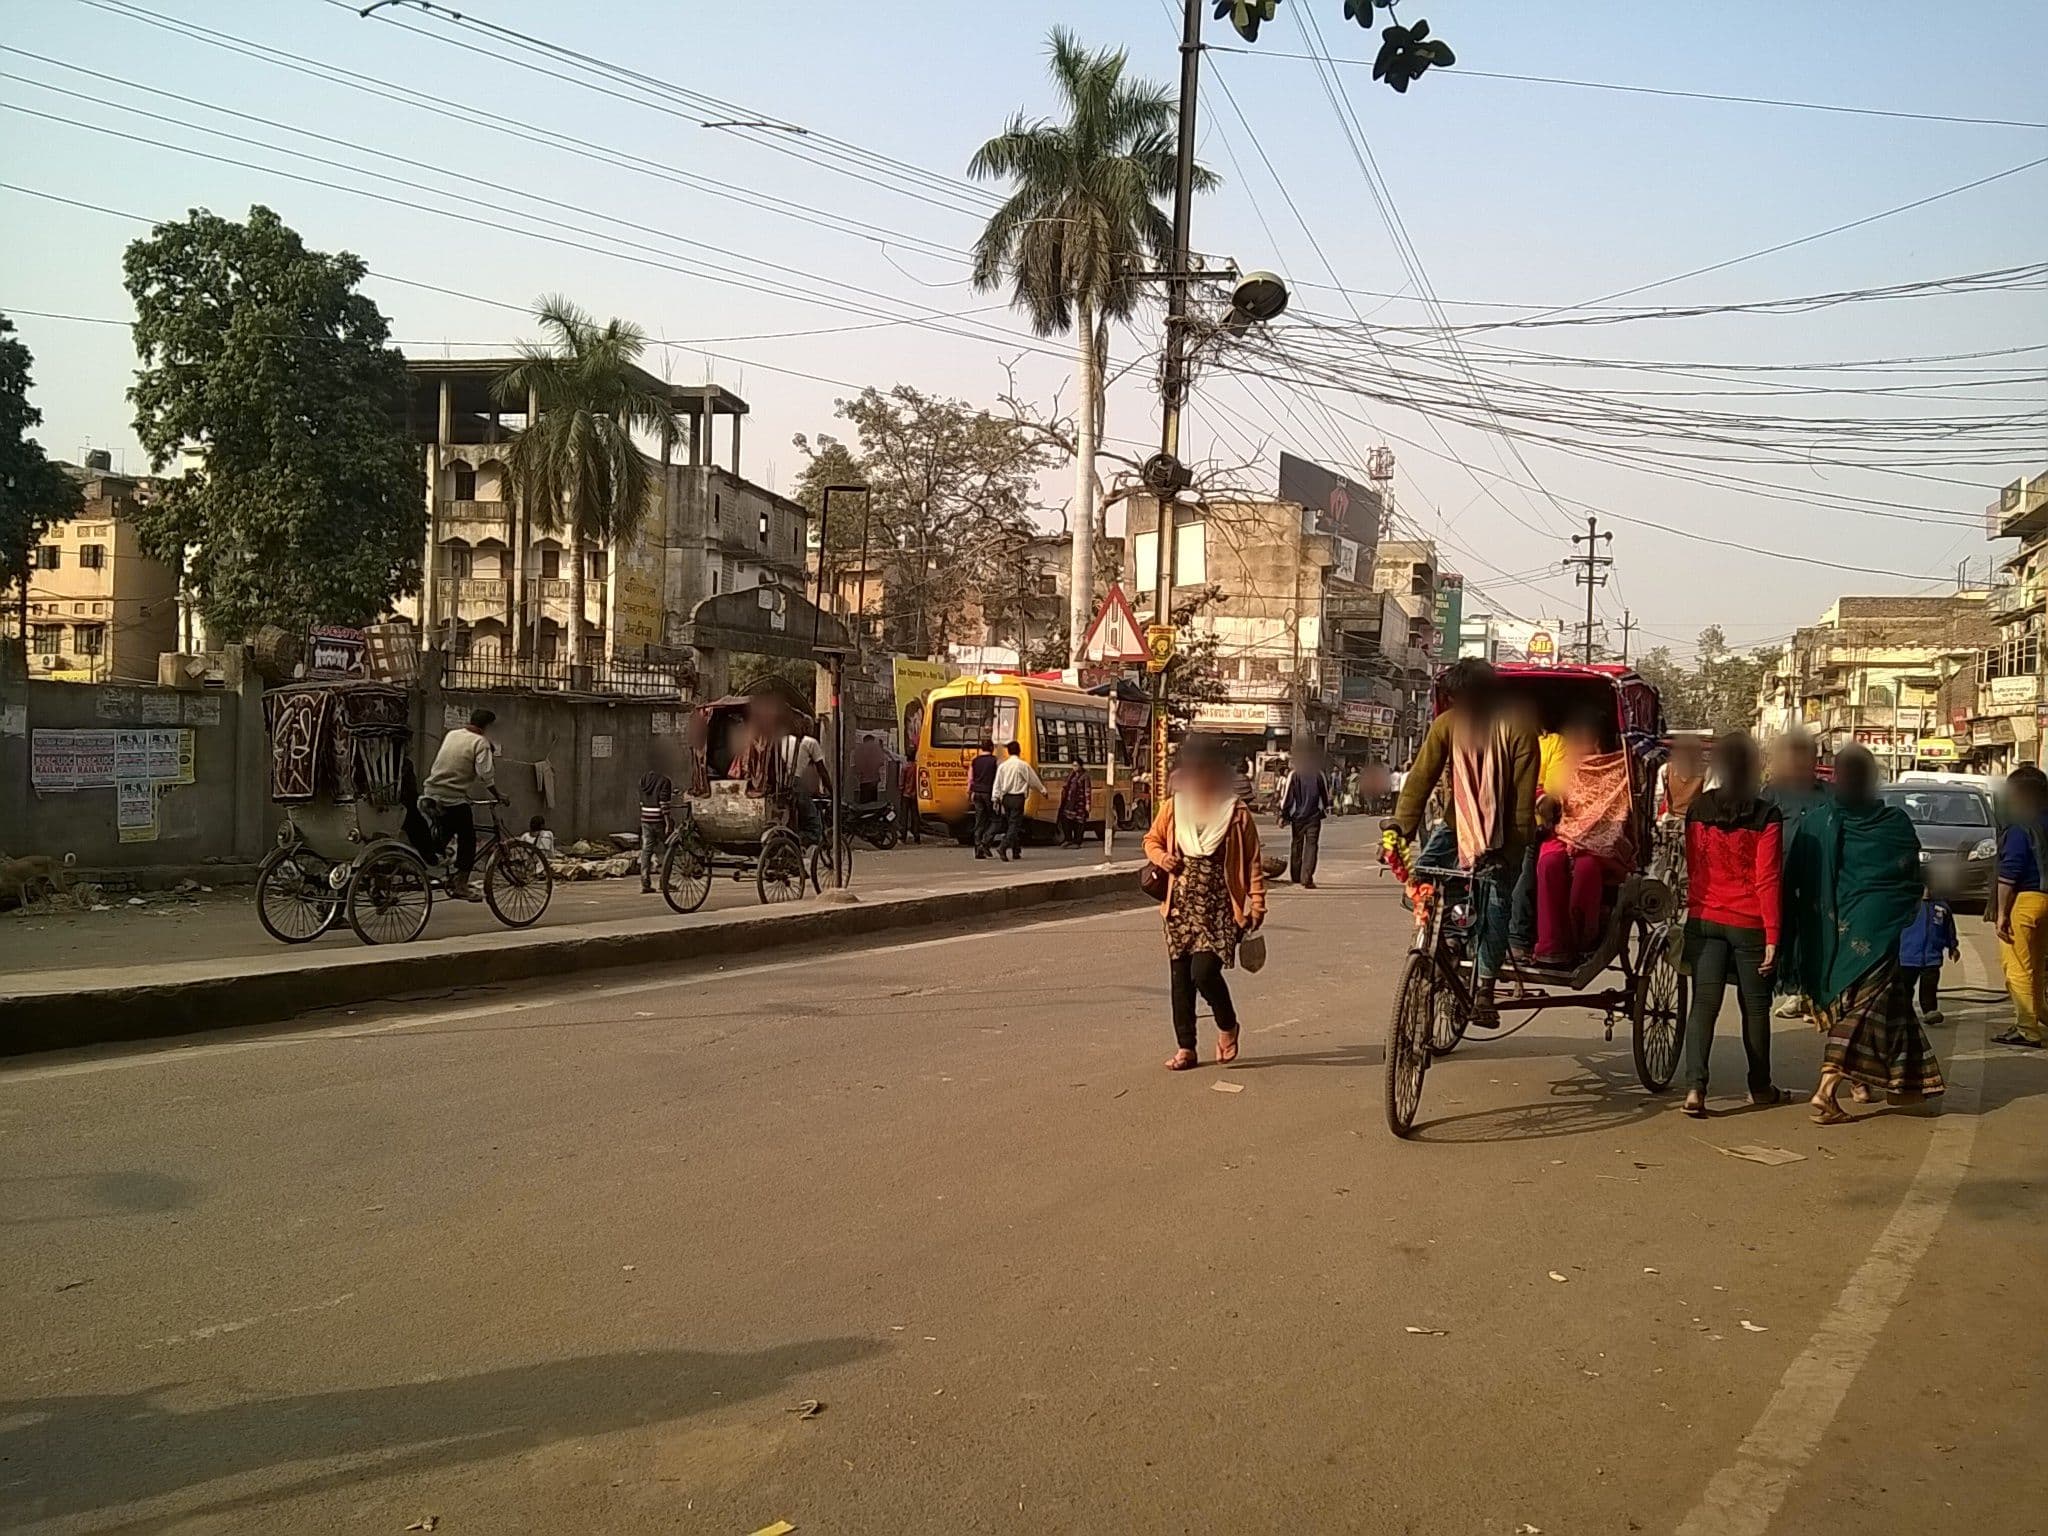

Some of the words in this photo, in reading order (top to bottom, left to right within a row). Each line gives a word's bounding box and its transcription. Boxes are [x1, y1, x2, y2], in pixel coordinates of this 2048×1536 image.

[1529, 640, 1553, 652] SALE
[1154, 718, 1165, 798] KIDZEE
[35, 765, 74, 774] RAILWAY
[76, 765, 114, 774] RAILWAY
